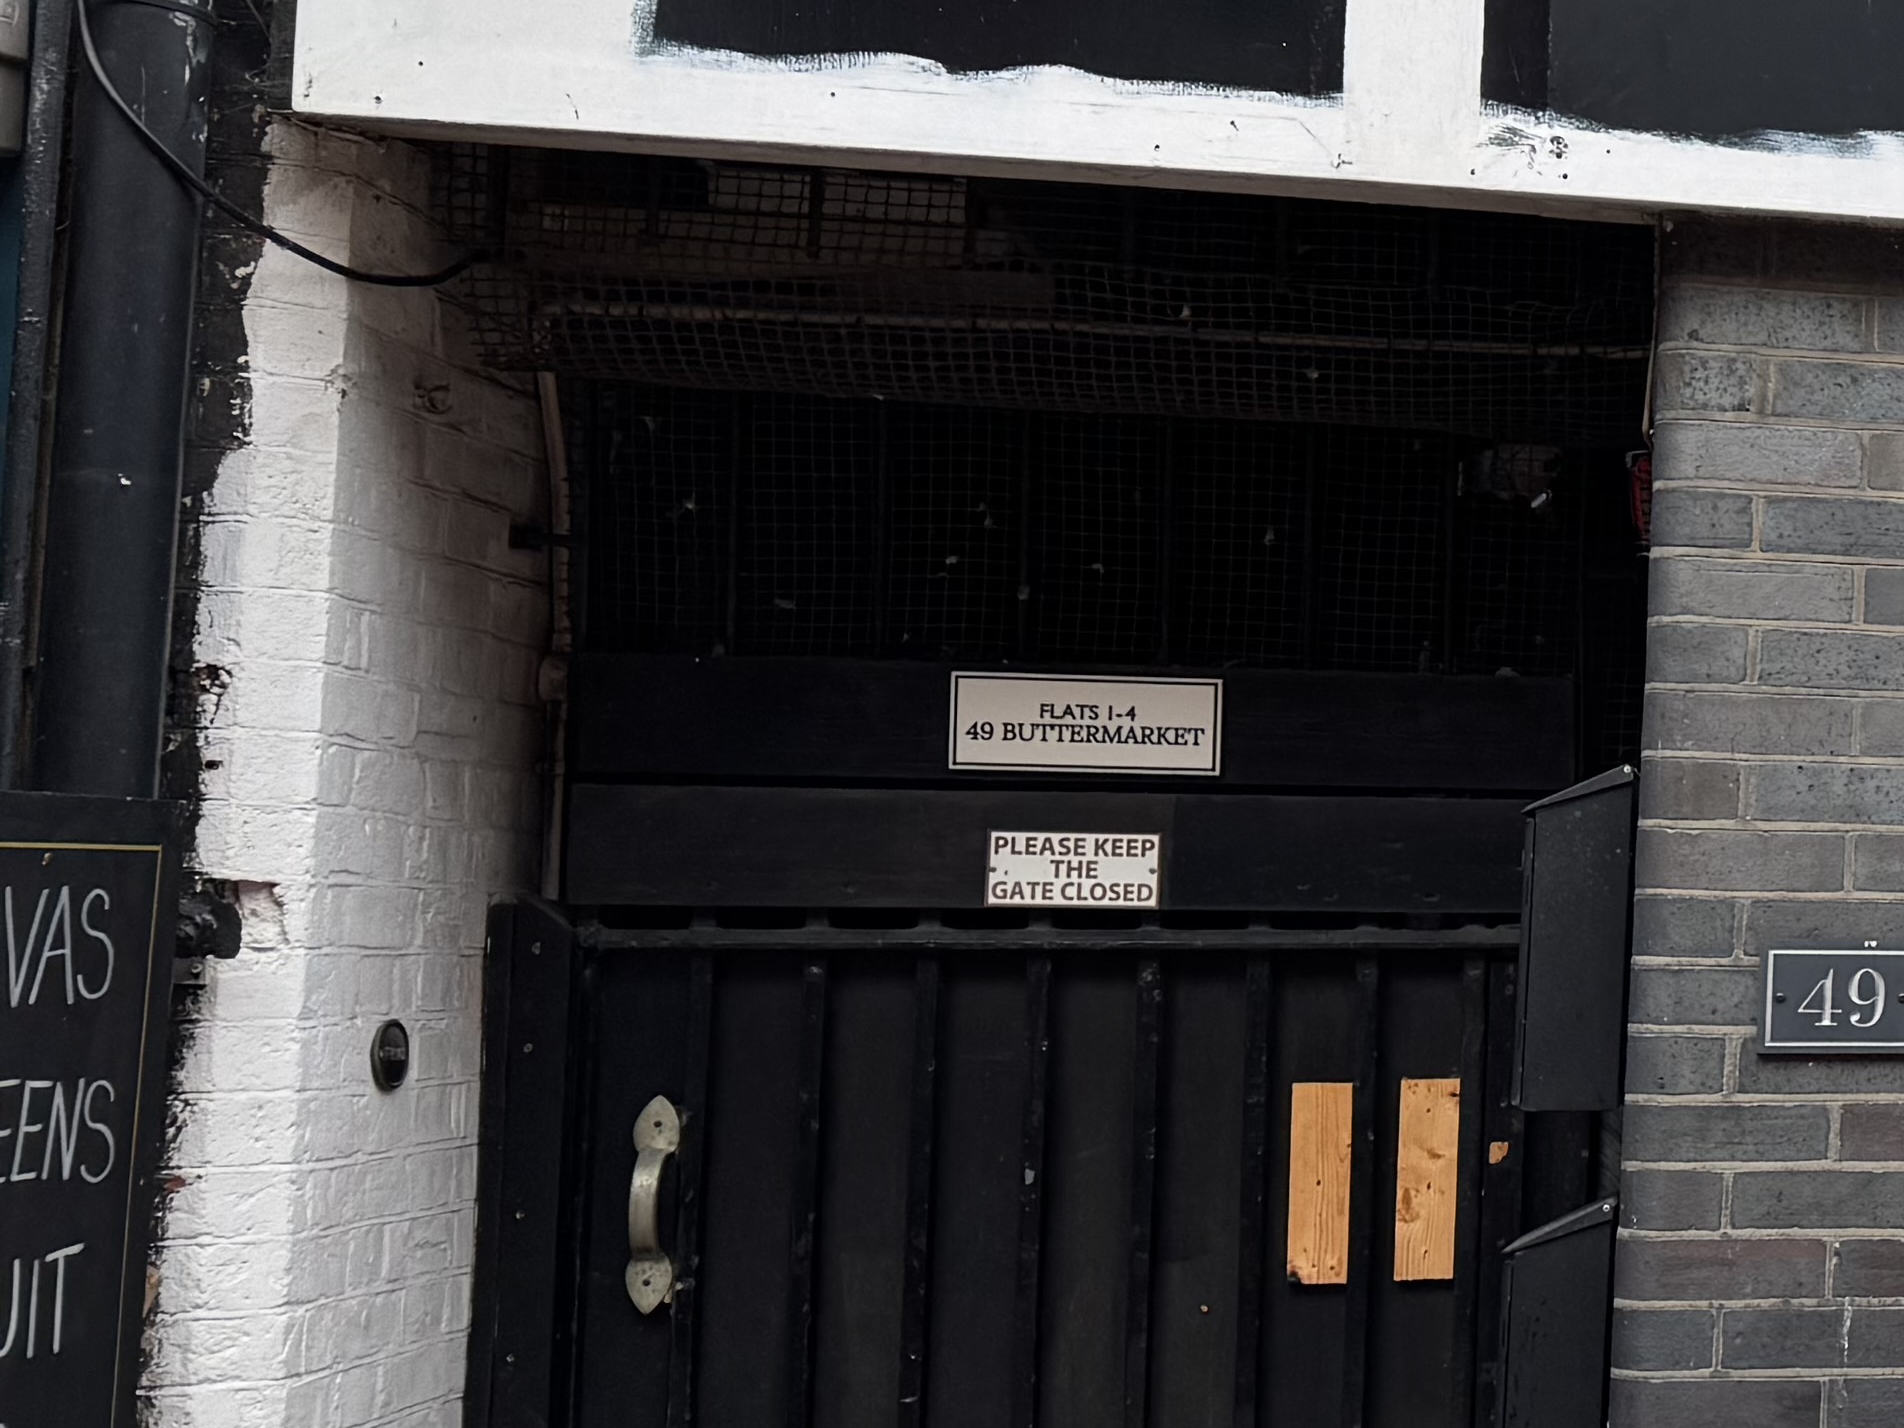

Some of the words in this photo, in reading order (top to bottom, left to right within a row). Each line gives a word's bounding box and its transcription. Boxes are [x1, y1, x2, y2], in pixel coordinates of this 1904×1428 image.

[1040, 703, 1099, 720] FLATS
[1108, 705, 1136, 722] 1-4
[965, 721, 994, 740] 49
[1002, 722, 1205, 746] BUTTERMARKET
[994, 836, 1086, 856] PLEASE
[1094, 838, 1155, 858] KEEP
[1050, 860, 1098, 879] THE
[992, 881, 1054, 900] GATE
[1061, 882, 1153, 902] CLOSED
[5, 885, 114, 1008] VAS
[1798, 968, 1885, 1027] 49
